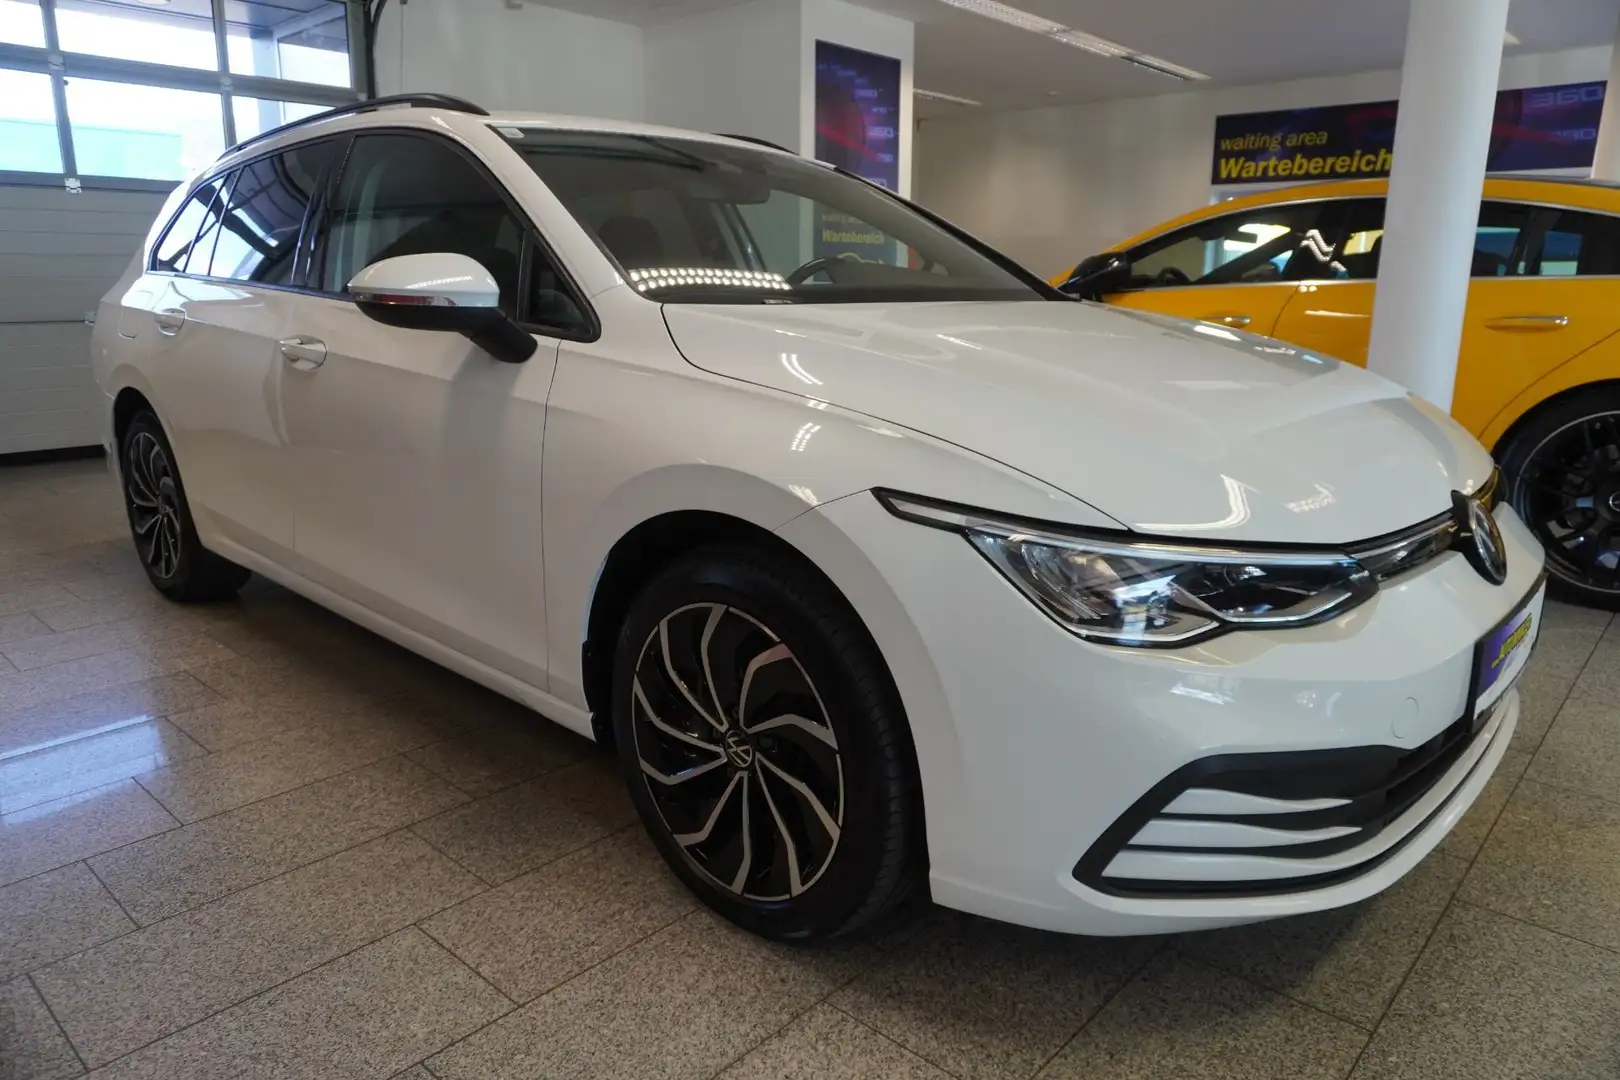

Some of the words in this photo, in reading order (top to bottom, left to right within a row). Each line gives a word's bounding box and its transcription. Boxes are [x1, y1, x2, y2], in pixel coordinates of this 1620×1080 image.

[1220, 132, 1283, 151] waiting
[1286, 131, 1328, 147] area
[1219, 148, 1392, 179] Wartebereich
[822, 228, 884, 245] Wartebereich
